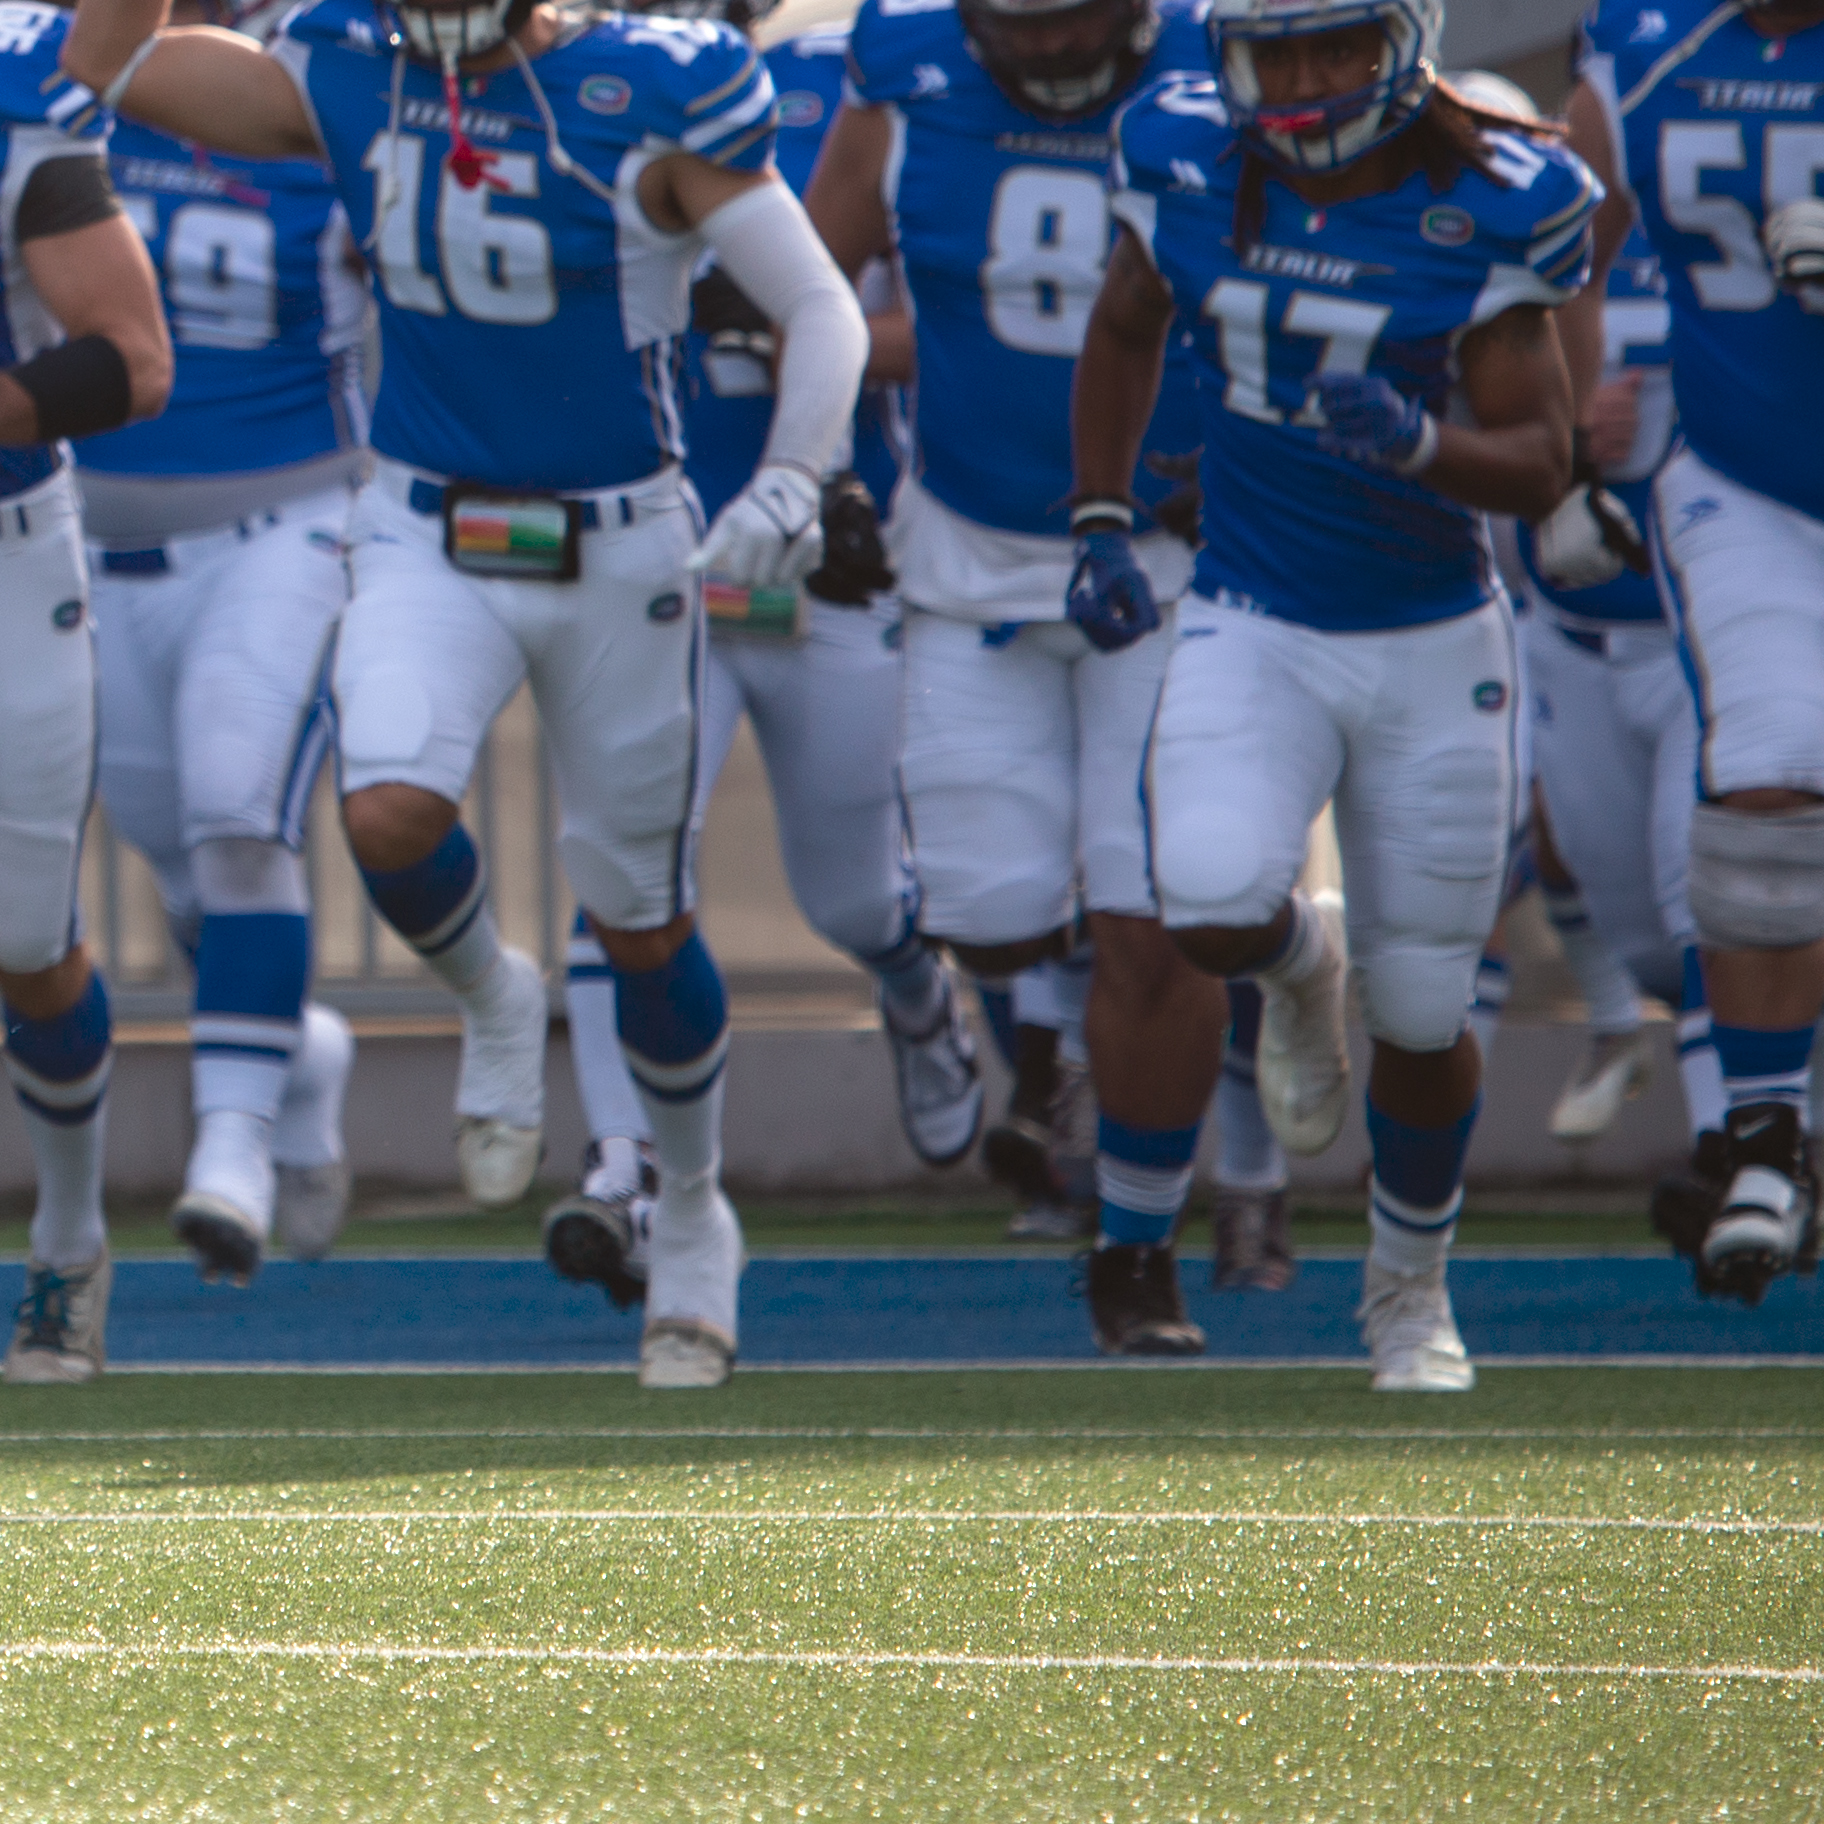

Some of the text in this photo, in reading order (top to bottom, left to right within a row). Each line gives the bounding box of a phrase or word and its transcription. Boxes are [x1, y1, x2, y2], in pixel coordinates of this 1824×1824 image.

[1700, 79, 1816, 111] ITALIA
[121, 193, 279, 352] 9
[361, 131, 559, 325] 16
[977, 163, 1110, 359] 8
[1244, 244, 1356, 289] ITALIA
[1201, 276, 1394, 428] 17
